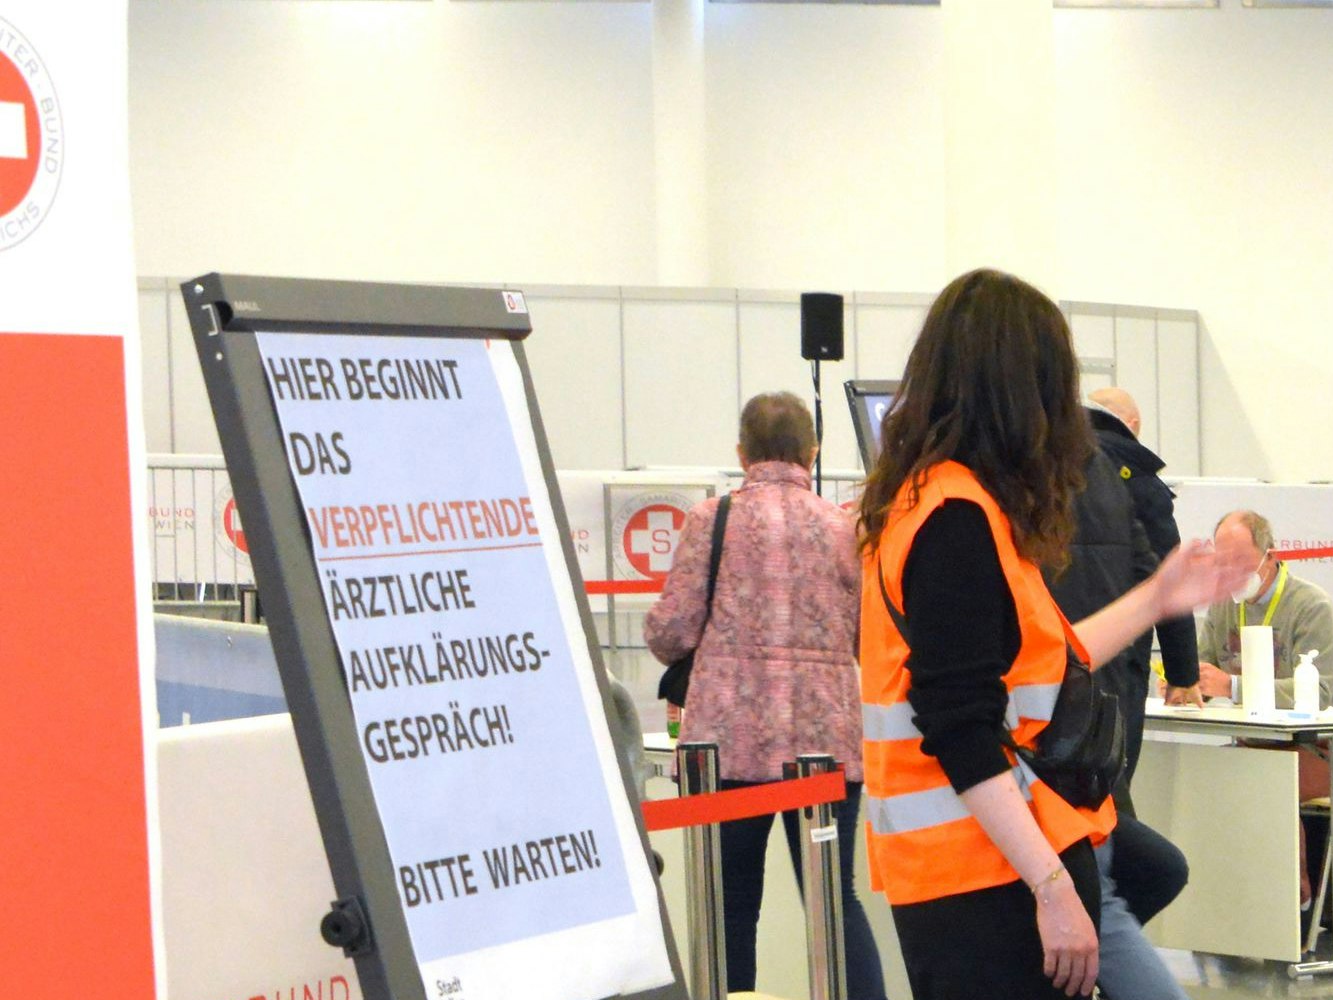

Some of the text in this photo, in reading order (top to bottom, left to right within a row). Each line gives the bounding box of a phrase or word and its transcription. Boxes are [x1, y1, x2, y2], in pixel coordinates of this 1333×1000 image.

[40, 96, 59, 175] BUND
[267, 357, 463, 401] HIER BEGINNT
[289, 431, 352, 476] DAS
[308, 496, 540, 549] VERPFLICHTENDE
[651, 528, 672, 555] S
[325, 569, 476, 621] ÄRZTLICHE
[350, 631, 551, 692] AUFKLÄRUNGS-
[363, 700, 515, 763] GESPRÄCH!
[399, 829, 602, 907] BITTE WARTEN!
[436, 976, 463, 995] Stadt
